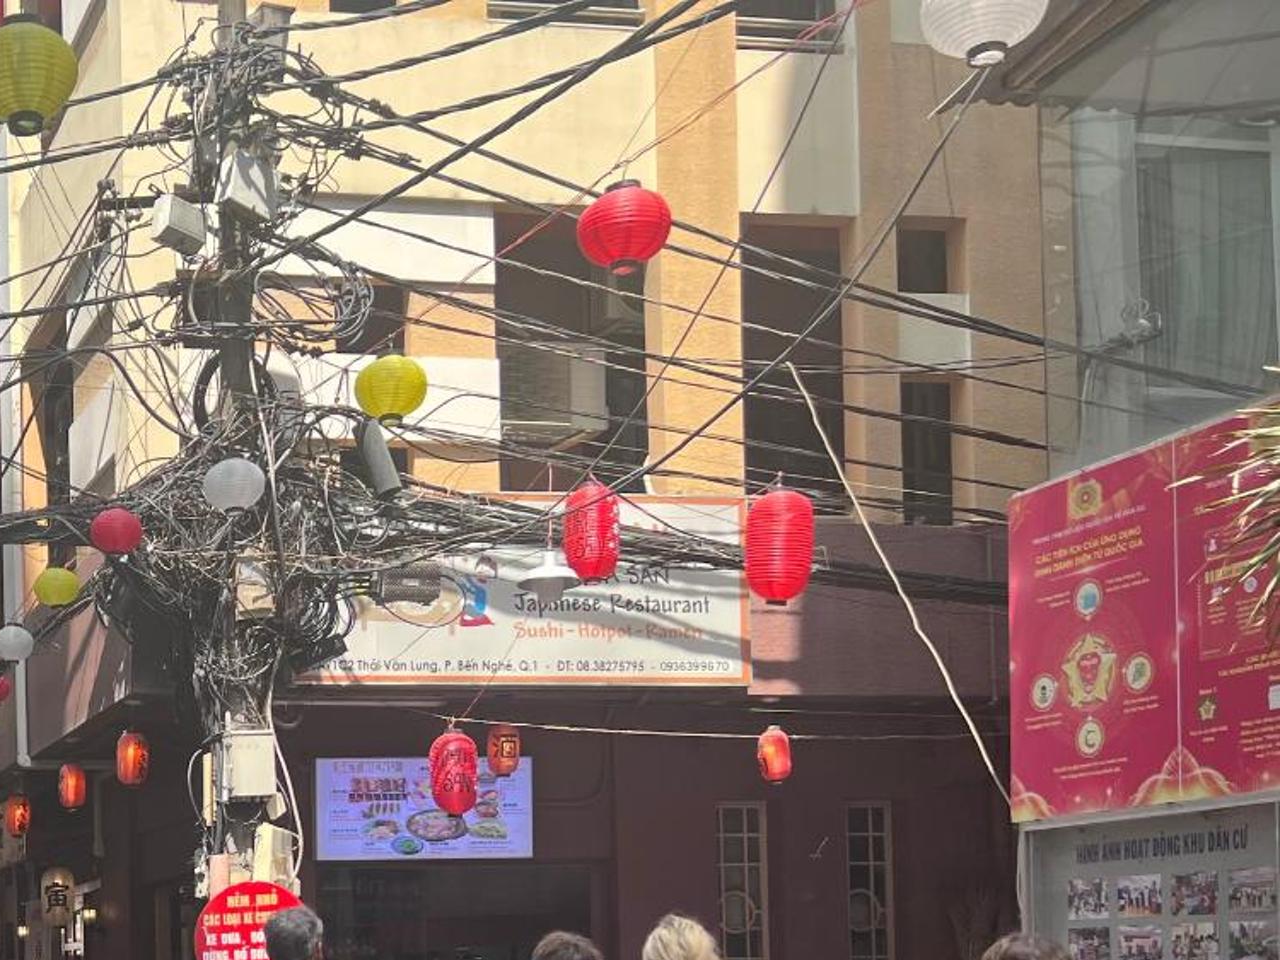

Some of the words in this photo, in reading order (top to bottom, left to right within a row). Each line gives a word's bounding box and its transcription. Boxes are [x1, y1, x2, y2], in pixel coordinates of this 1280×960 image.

[627, 566, 669, 585] SAN
[513, 592, 601, 617] Japanese
[609, 593, 710, 614] Restaurant
[513, 620, 564, 640] Sushi
[1182, 831, 1205, 856] KHU
[1208, 825, 1230, 853] DÂN
[1233, 824, 1249, 850] CƯ
